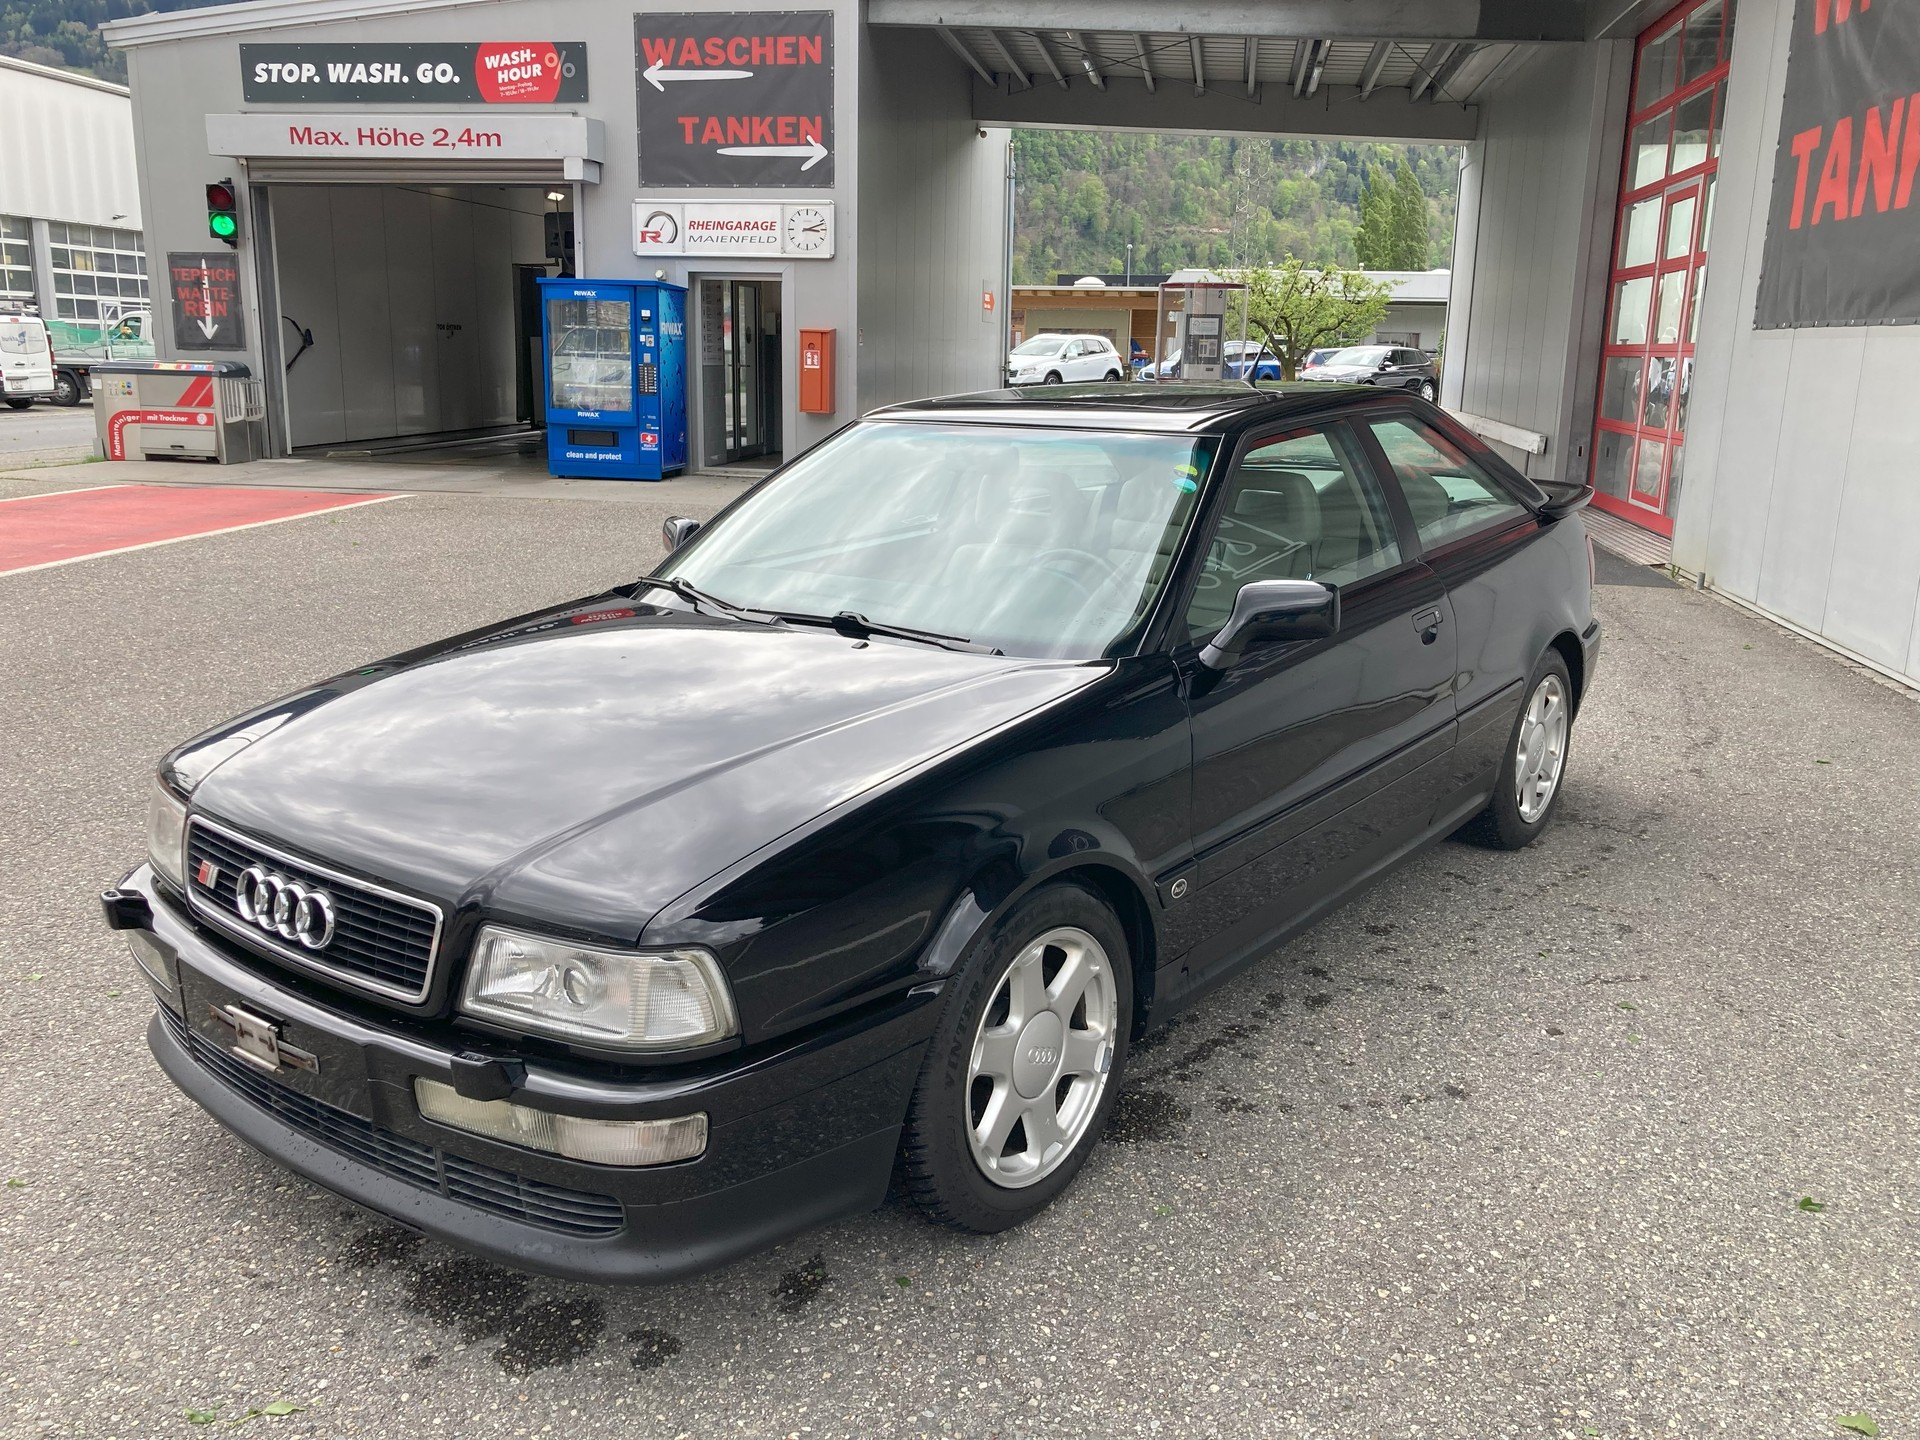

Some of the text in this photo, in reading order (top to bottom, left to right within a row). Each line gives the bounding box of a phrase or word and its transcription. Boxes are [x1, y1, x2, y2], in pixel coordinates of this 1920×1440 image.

[485, 48, 536, 70] WASH-
[641, 36, 822, 66] WASCHEN
[254, 62, 460, 84] STOP. WASH. GO.
[497, 63, 543, 84] HOUR
[289, 126, 502, 150] Max. Höhe 2,4m
[677, 116, 822, 145] TANKEN
[688, 219, 777, 231] RHEINGARAGE
[688, 235, 778, 244] MAIENFELD
[171, 267, 236, 282] TEPPICH
[1218, 290, 1223, 298] 2
[184, 300, 228, 317] REIN
[660, 322, 682, 336] RIWAX
[114, 413, 188, 457] Mattenreiniger mit Trockner
[566, 451, 584, 459] clean
[598, 452, 622, 461] protect
